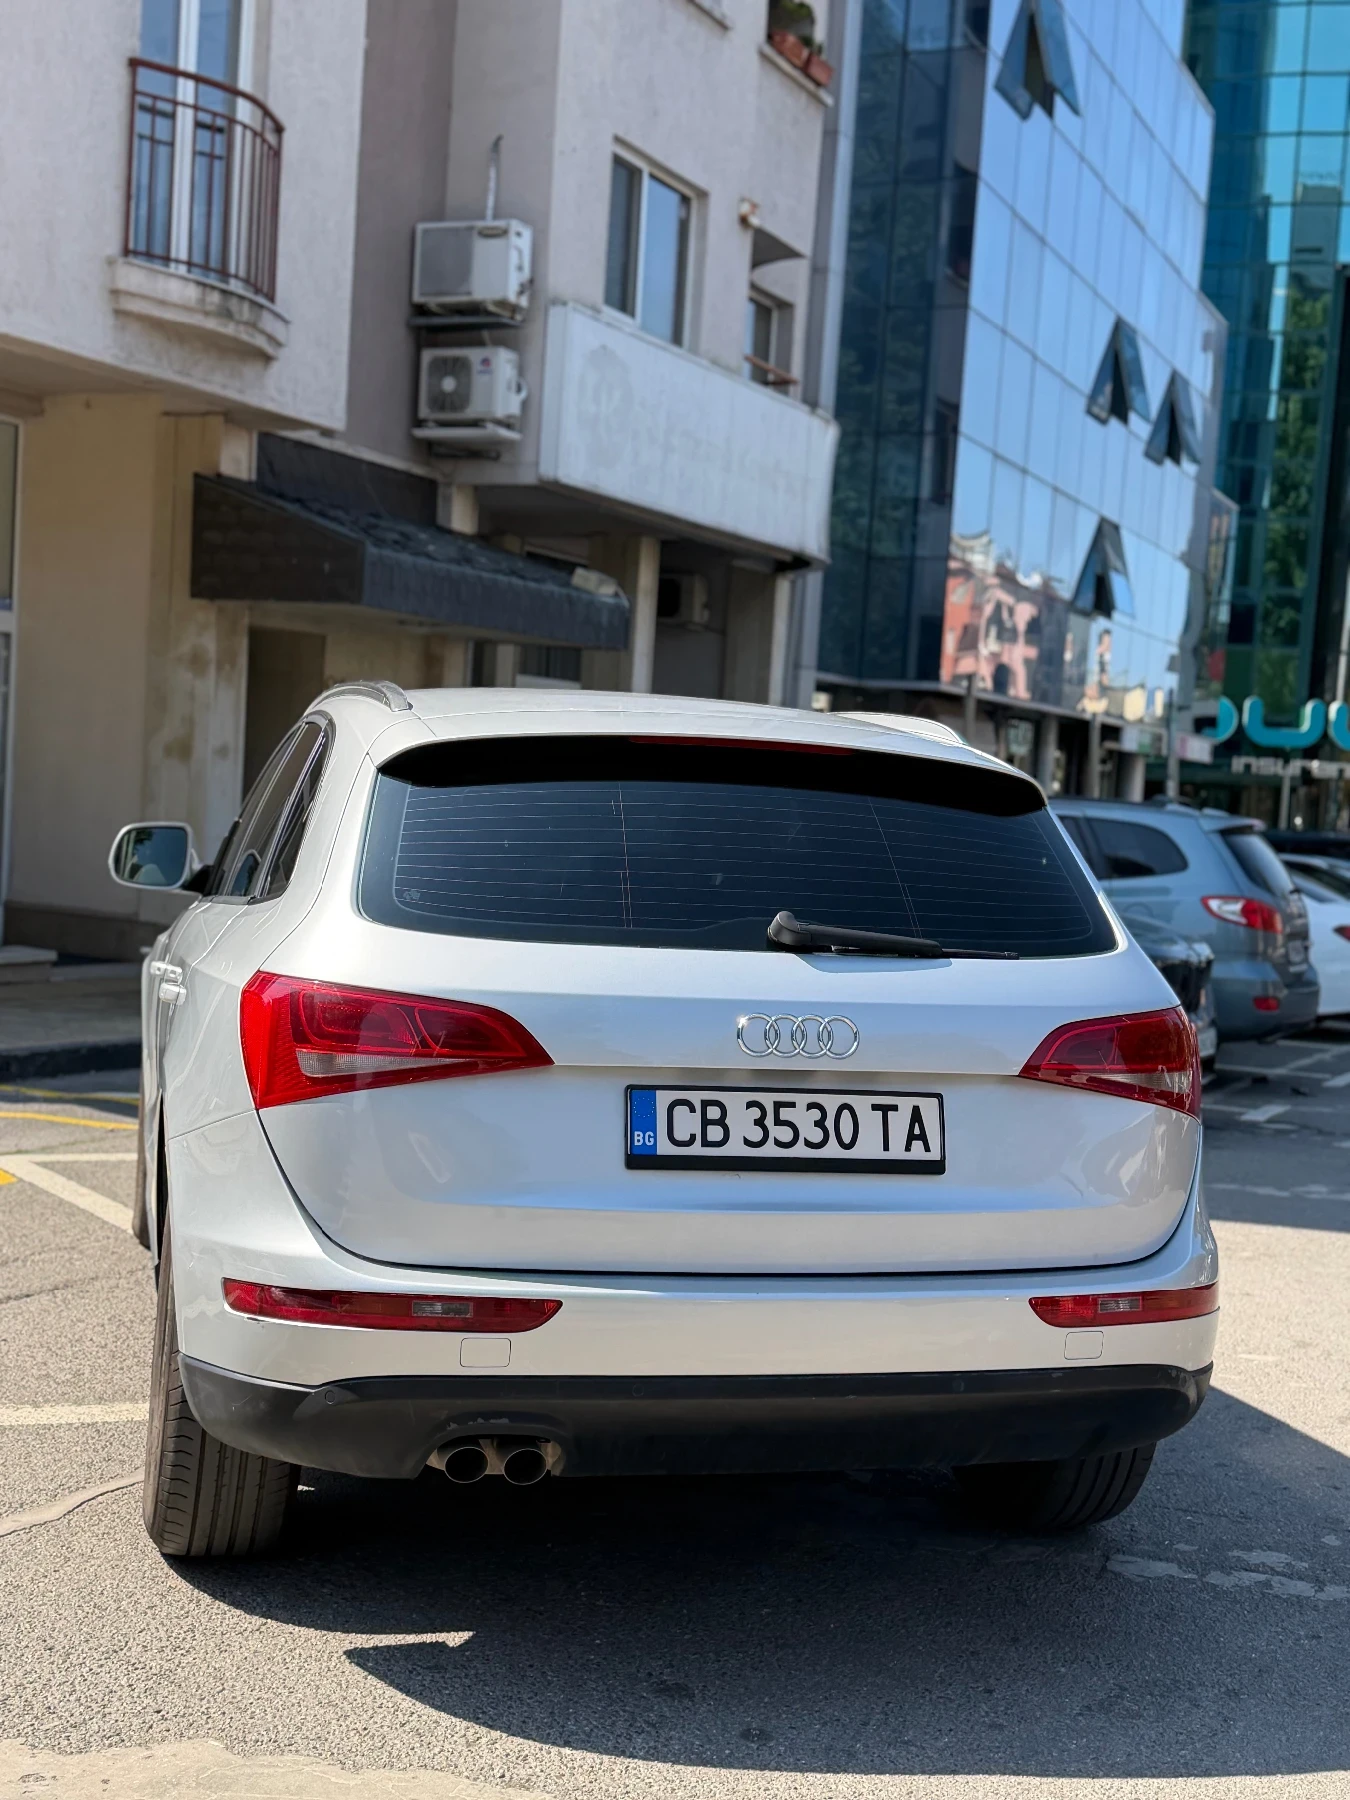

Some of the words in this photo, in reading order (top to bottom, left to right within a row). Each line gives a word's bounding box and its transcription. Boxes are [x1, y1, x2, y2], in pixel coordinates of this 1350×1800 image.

[634, 1131, 655, 1146] BG
[666, 1098, 730, 1148] CB
[743, 1100, 859, 1150] 3530
[871, 1103, 931, 1153] TA
